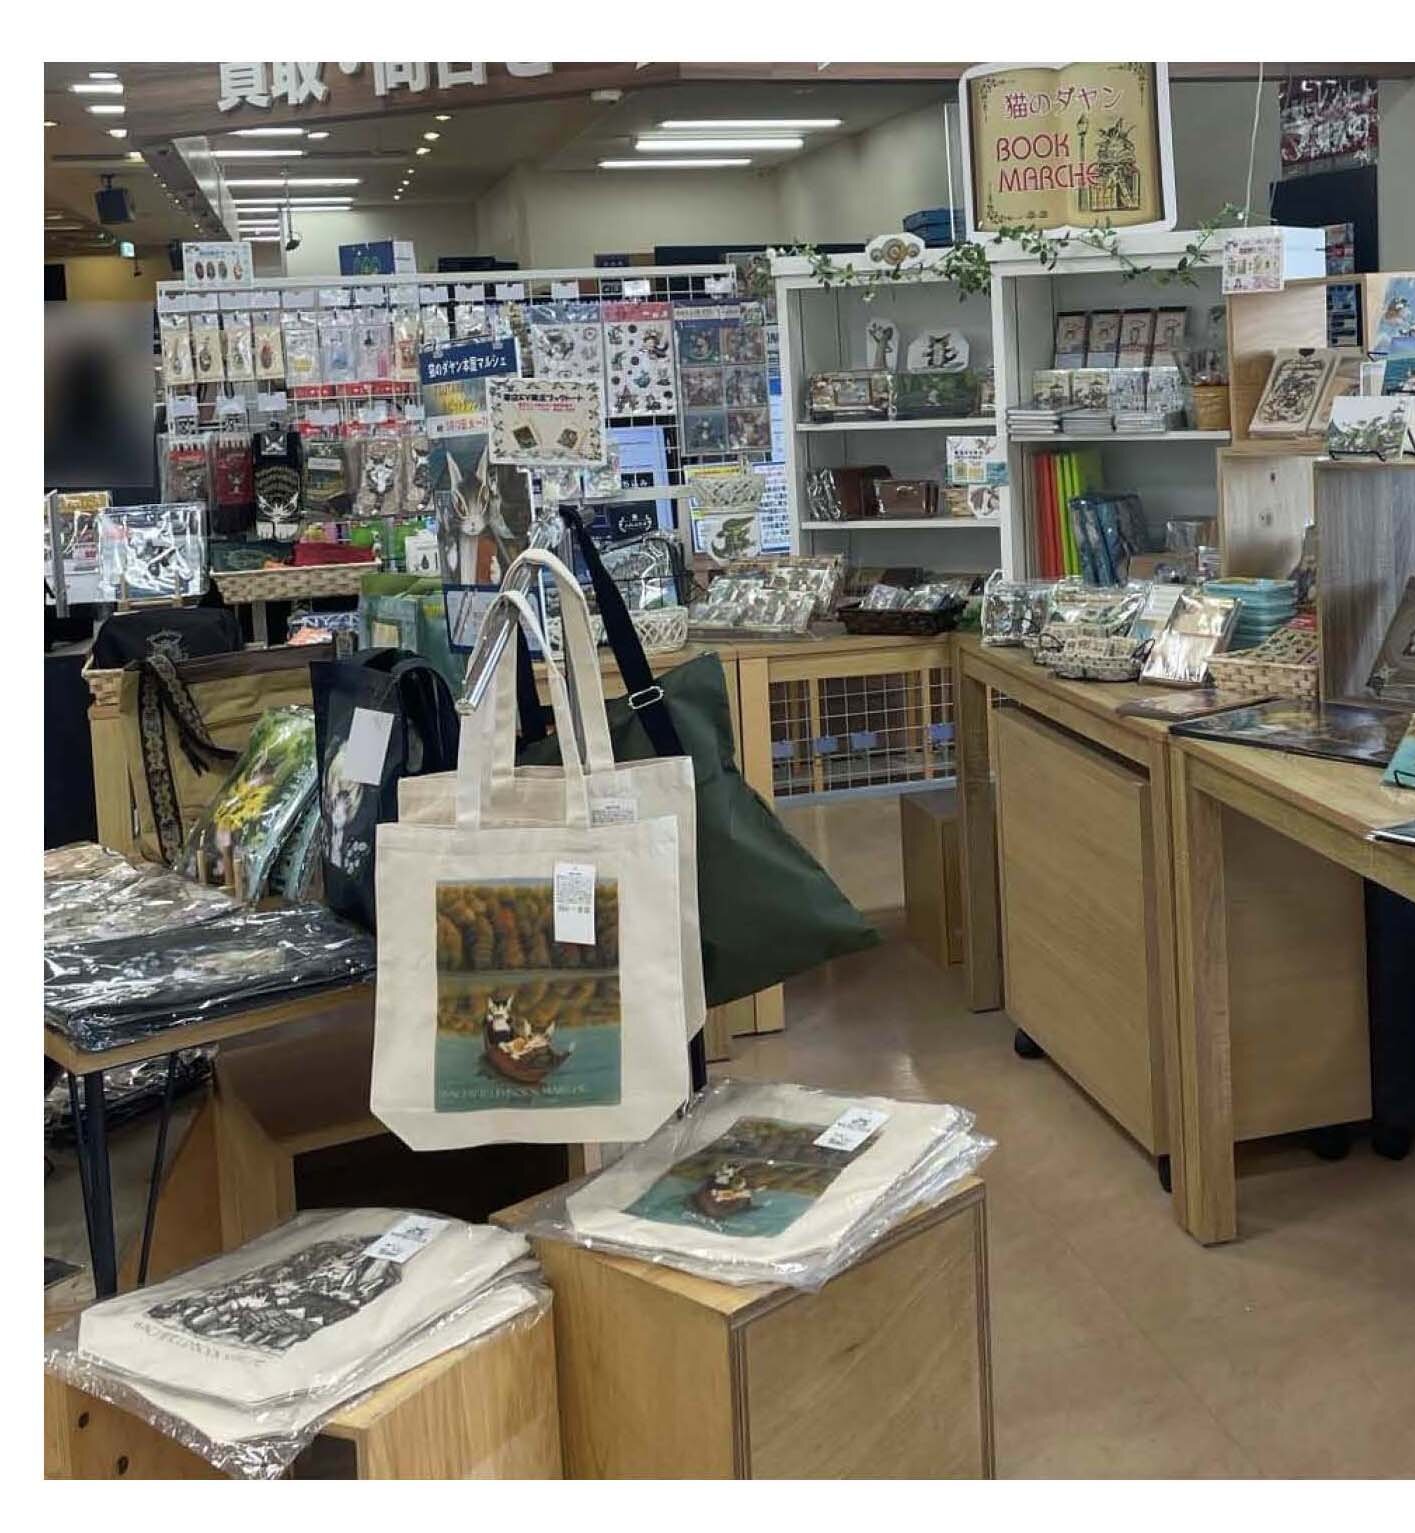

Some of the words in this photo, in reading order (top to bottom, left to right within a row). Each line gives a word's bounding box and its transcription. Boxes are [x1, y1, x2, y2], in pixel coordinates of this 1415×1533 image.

[1004, 86, 1122, 120] 猫のダヤン
[996, 133, 1070, 162] BOOK
